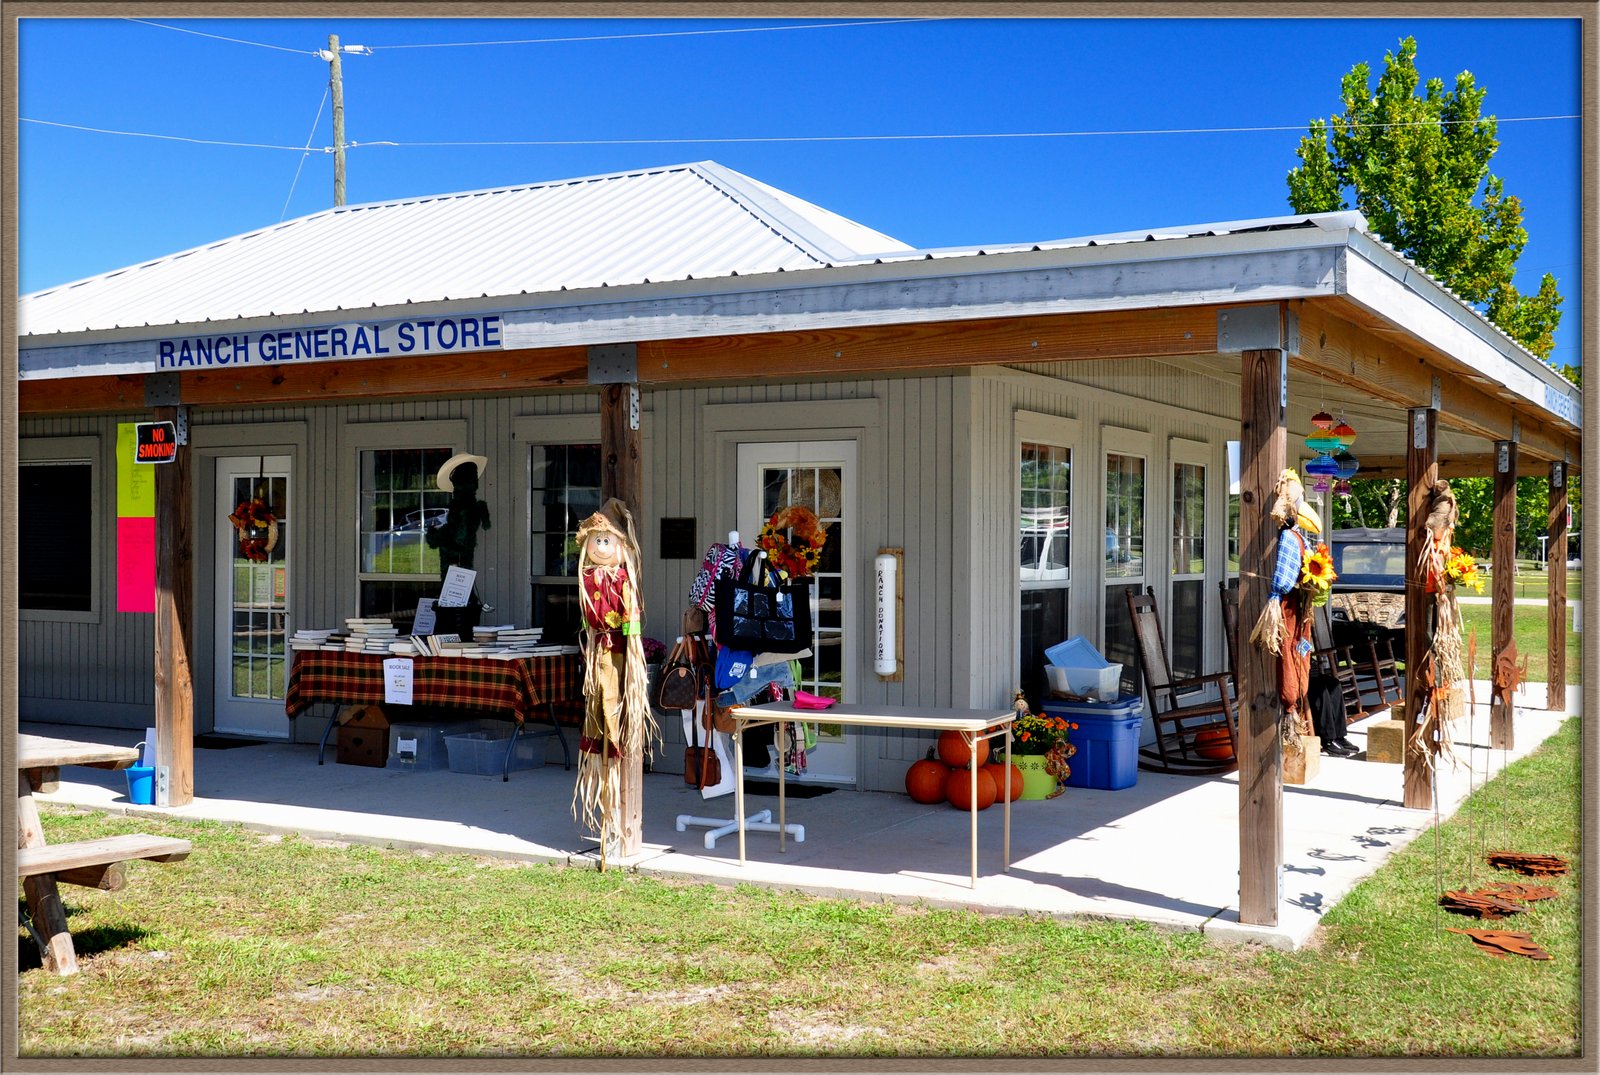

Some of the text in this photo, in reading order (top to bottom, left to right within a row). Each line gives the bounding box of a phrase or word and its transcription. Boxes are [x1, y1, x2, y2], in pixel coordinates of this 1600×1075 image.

[159, 316, 501, 368] RANCH GENERAL STORE
[152, 428, 165, 442] NO
[138, 442, 175, 458] SMOKING
